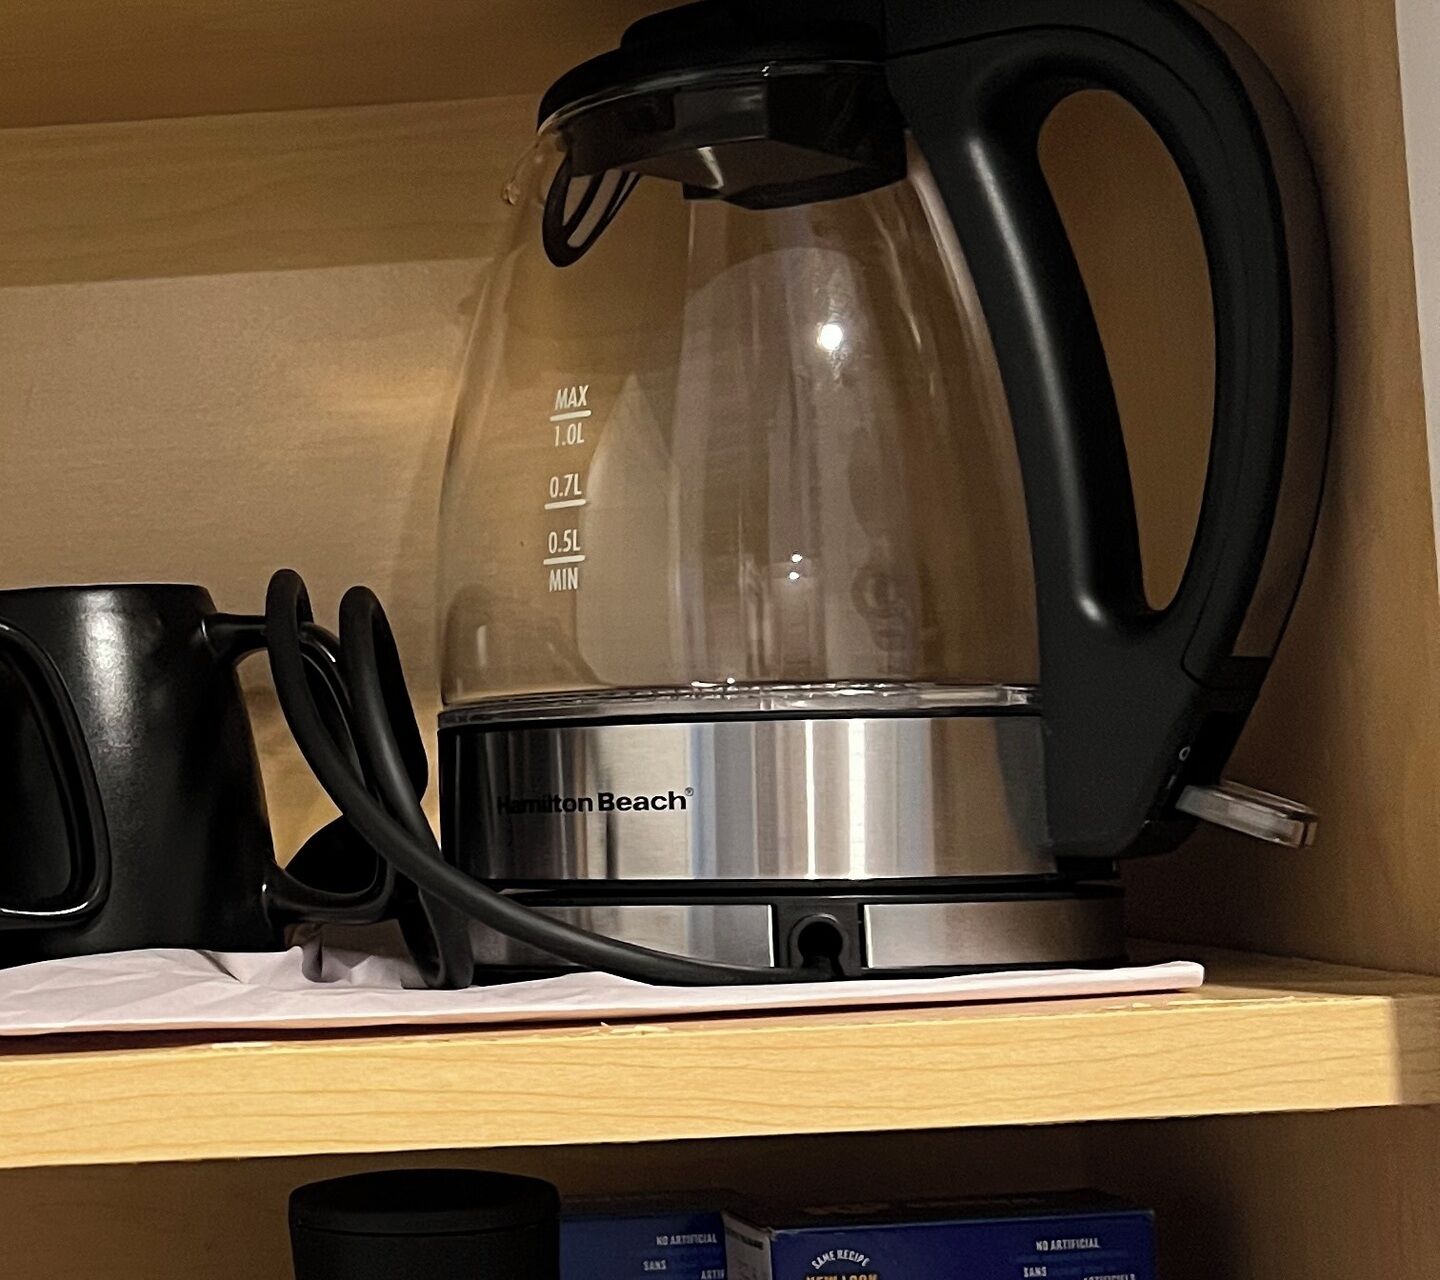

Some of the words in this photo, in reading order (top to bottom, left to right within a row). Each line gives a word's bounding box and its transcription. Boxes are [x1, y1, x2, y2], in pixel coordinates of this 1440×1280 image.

[555, 384, 589, 410] MAX
[554, 423, 585, 448] 1.0L
[549, 473, 582, 498] 0.7L
[547, 528, 581, 554] 0.5L
[548, 566, 579, 592] MIN
[497, 791, 593, 816] Hamilton
